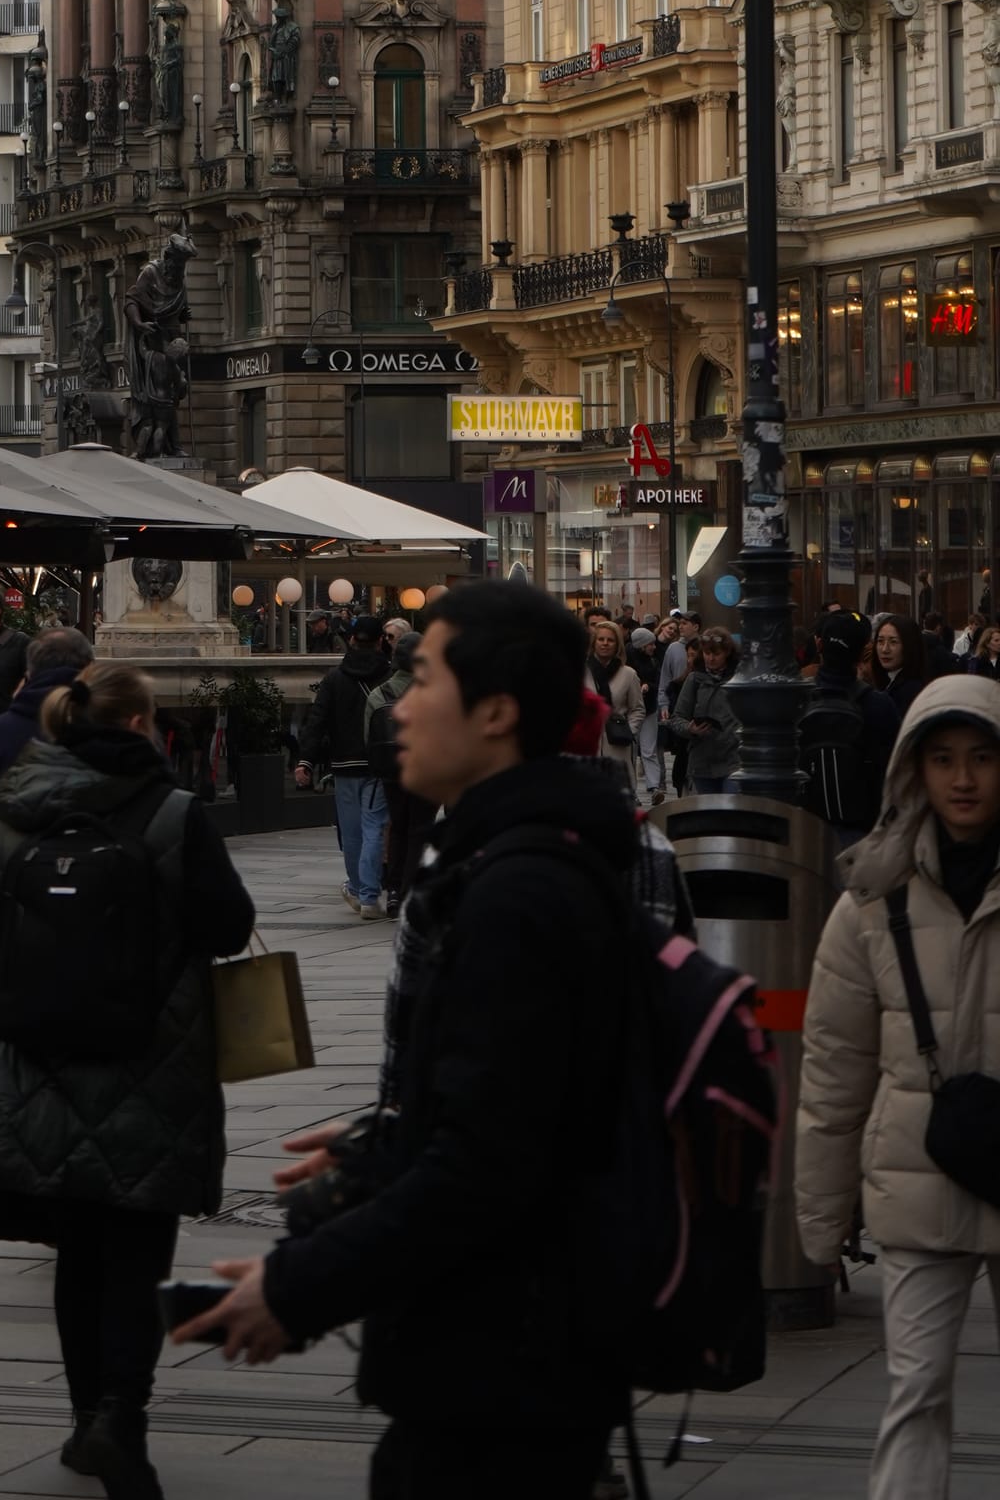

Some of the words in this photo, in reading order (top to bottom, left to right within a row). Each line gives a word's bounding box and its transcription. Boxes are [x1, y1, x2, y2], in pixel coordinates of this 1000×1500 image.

[235, 356, 260, 377] OMEGA
[362, 353, 445, 371] OMEGA
[460, 401, 575, 430] STURMAYR
[636, 488, 704, 504] APOTHEKE
